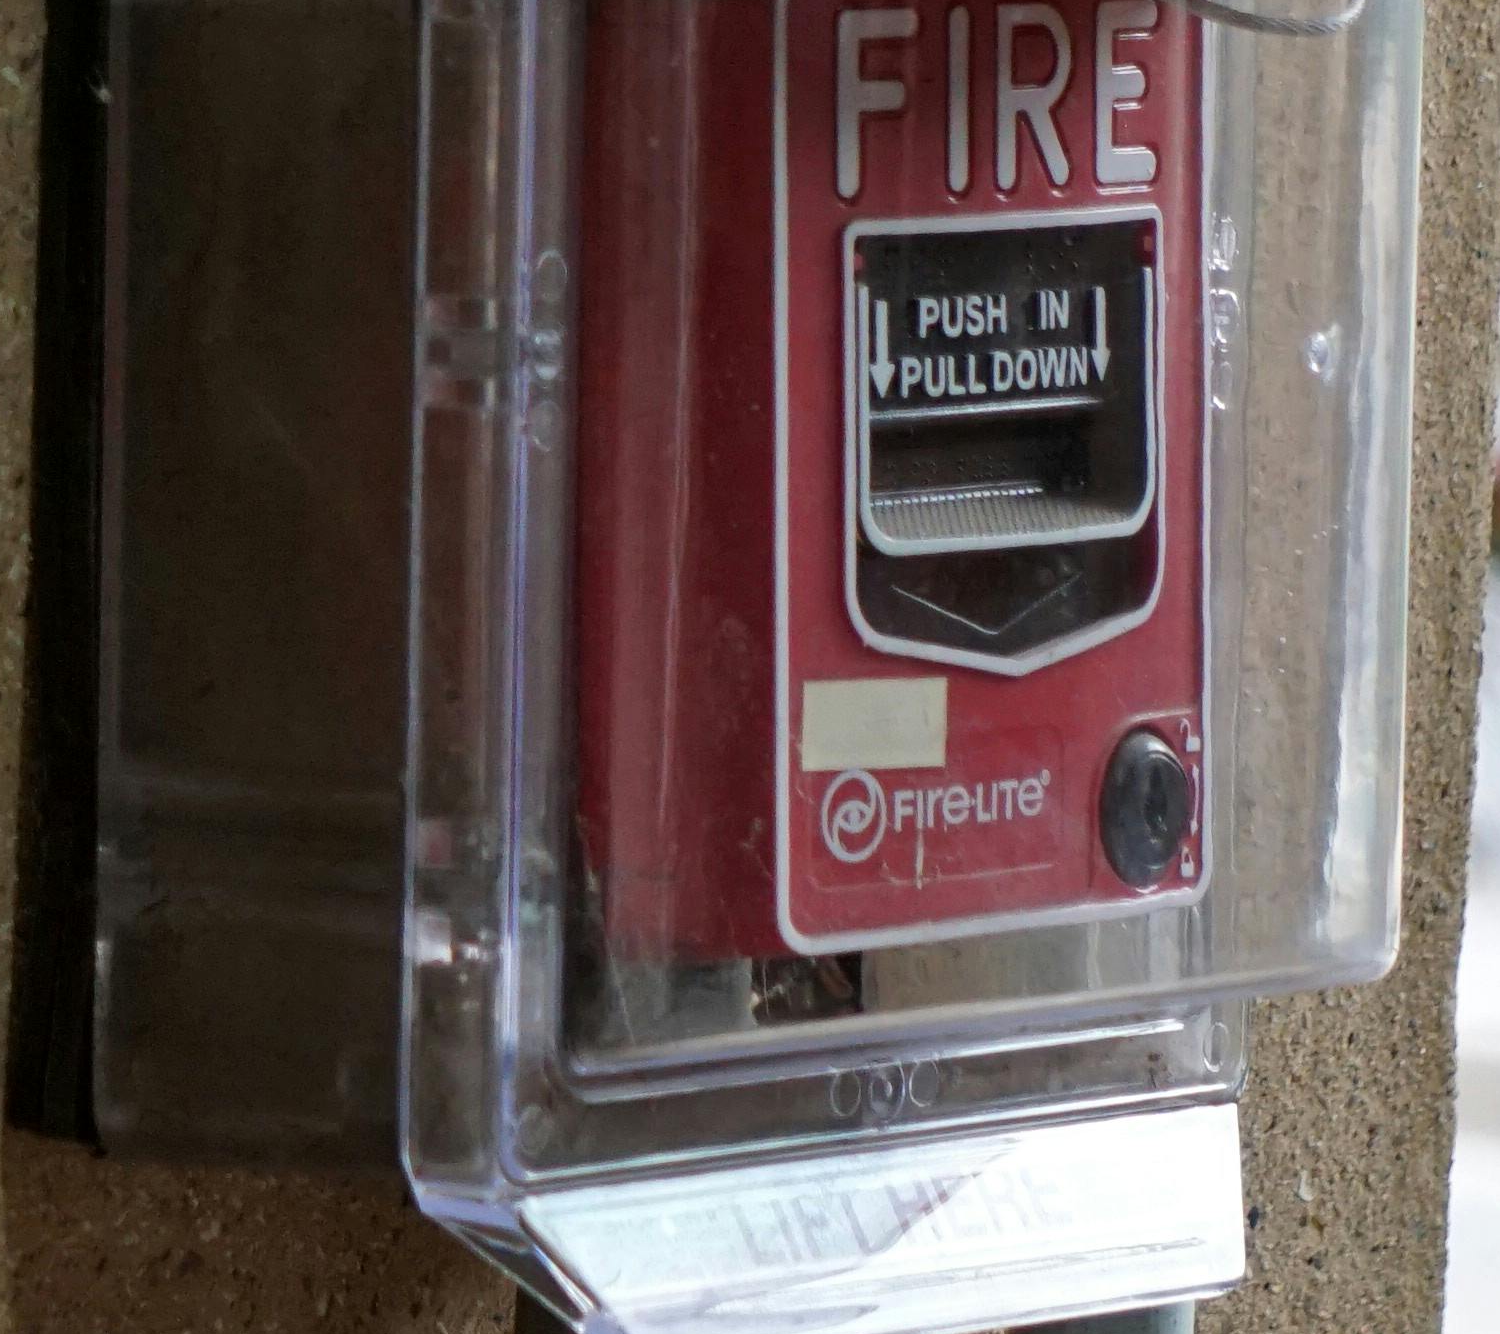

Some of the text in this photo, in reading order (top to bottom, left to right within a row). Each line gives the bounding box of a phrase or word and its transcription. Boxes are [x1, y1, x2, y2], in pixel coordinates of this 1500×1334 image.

[917, 289, 1070, 339] PUSH IN
[900, 347, 1088, 399] PULL DOWN
[884, 1167, 1073, 1245] HERE
